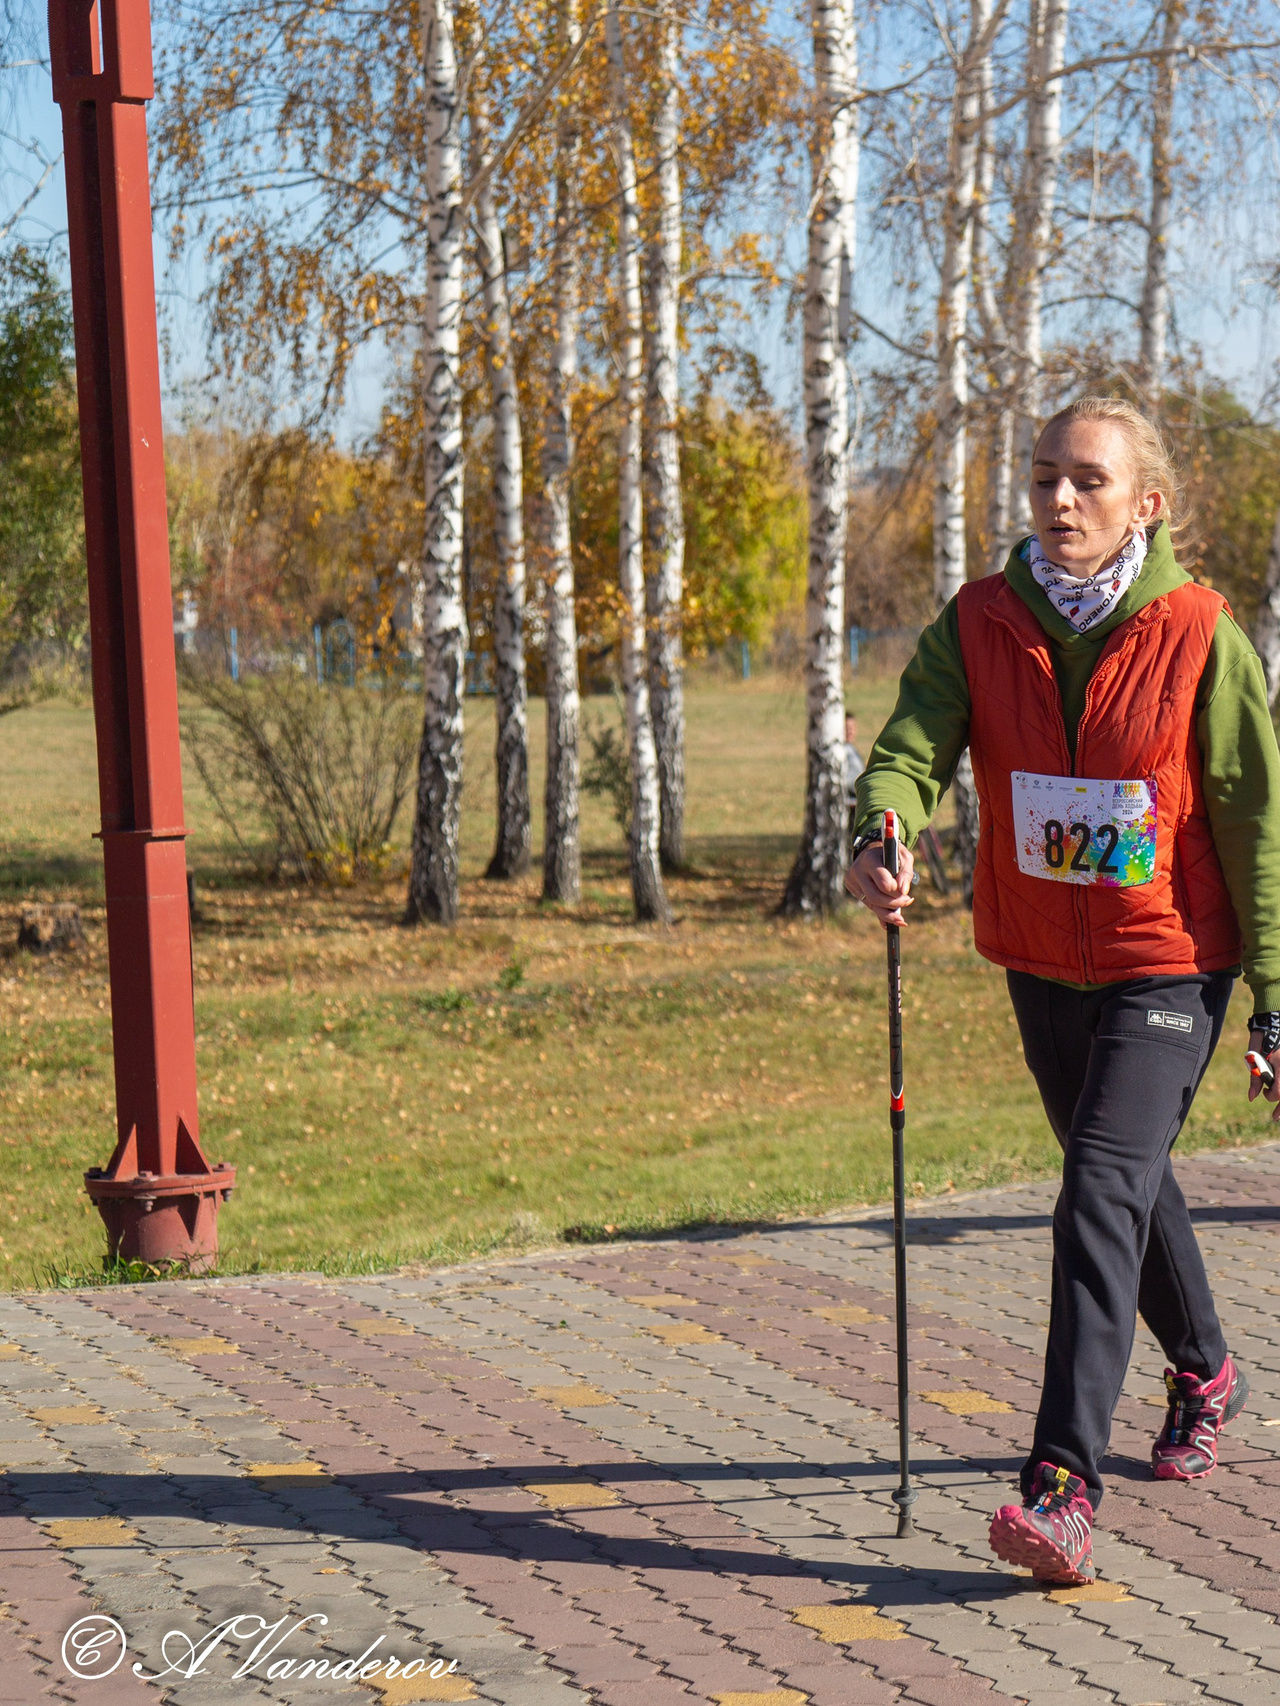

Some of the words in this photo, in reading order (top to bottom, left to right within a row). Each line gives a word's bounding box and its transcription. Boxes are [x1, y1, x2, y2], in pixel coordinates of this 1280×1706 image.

[1078, 592, 1116, 632] TORERO
[1045, 819, 1119, 873] 822
[1268, 1012, 1280, 1043] LEKI
